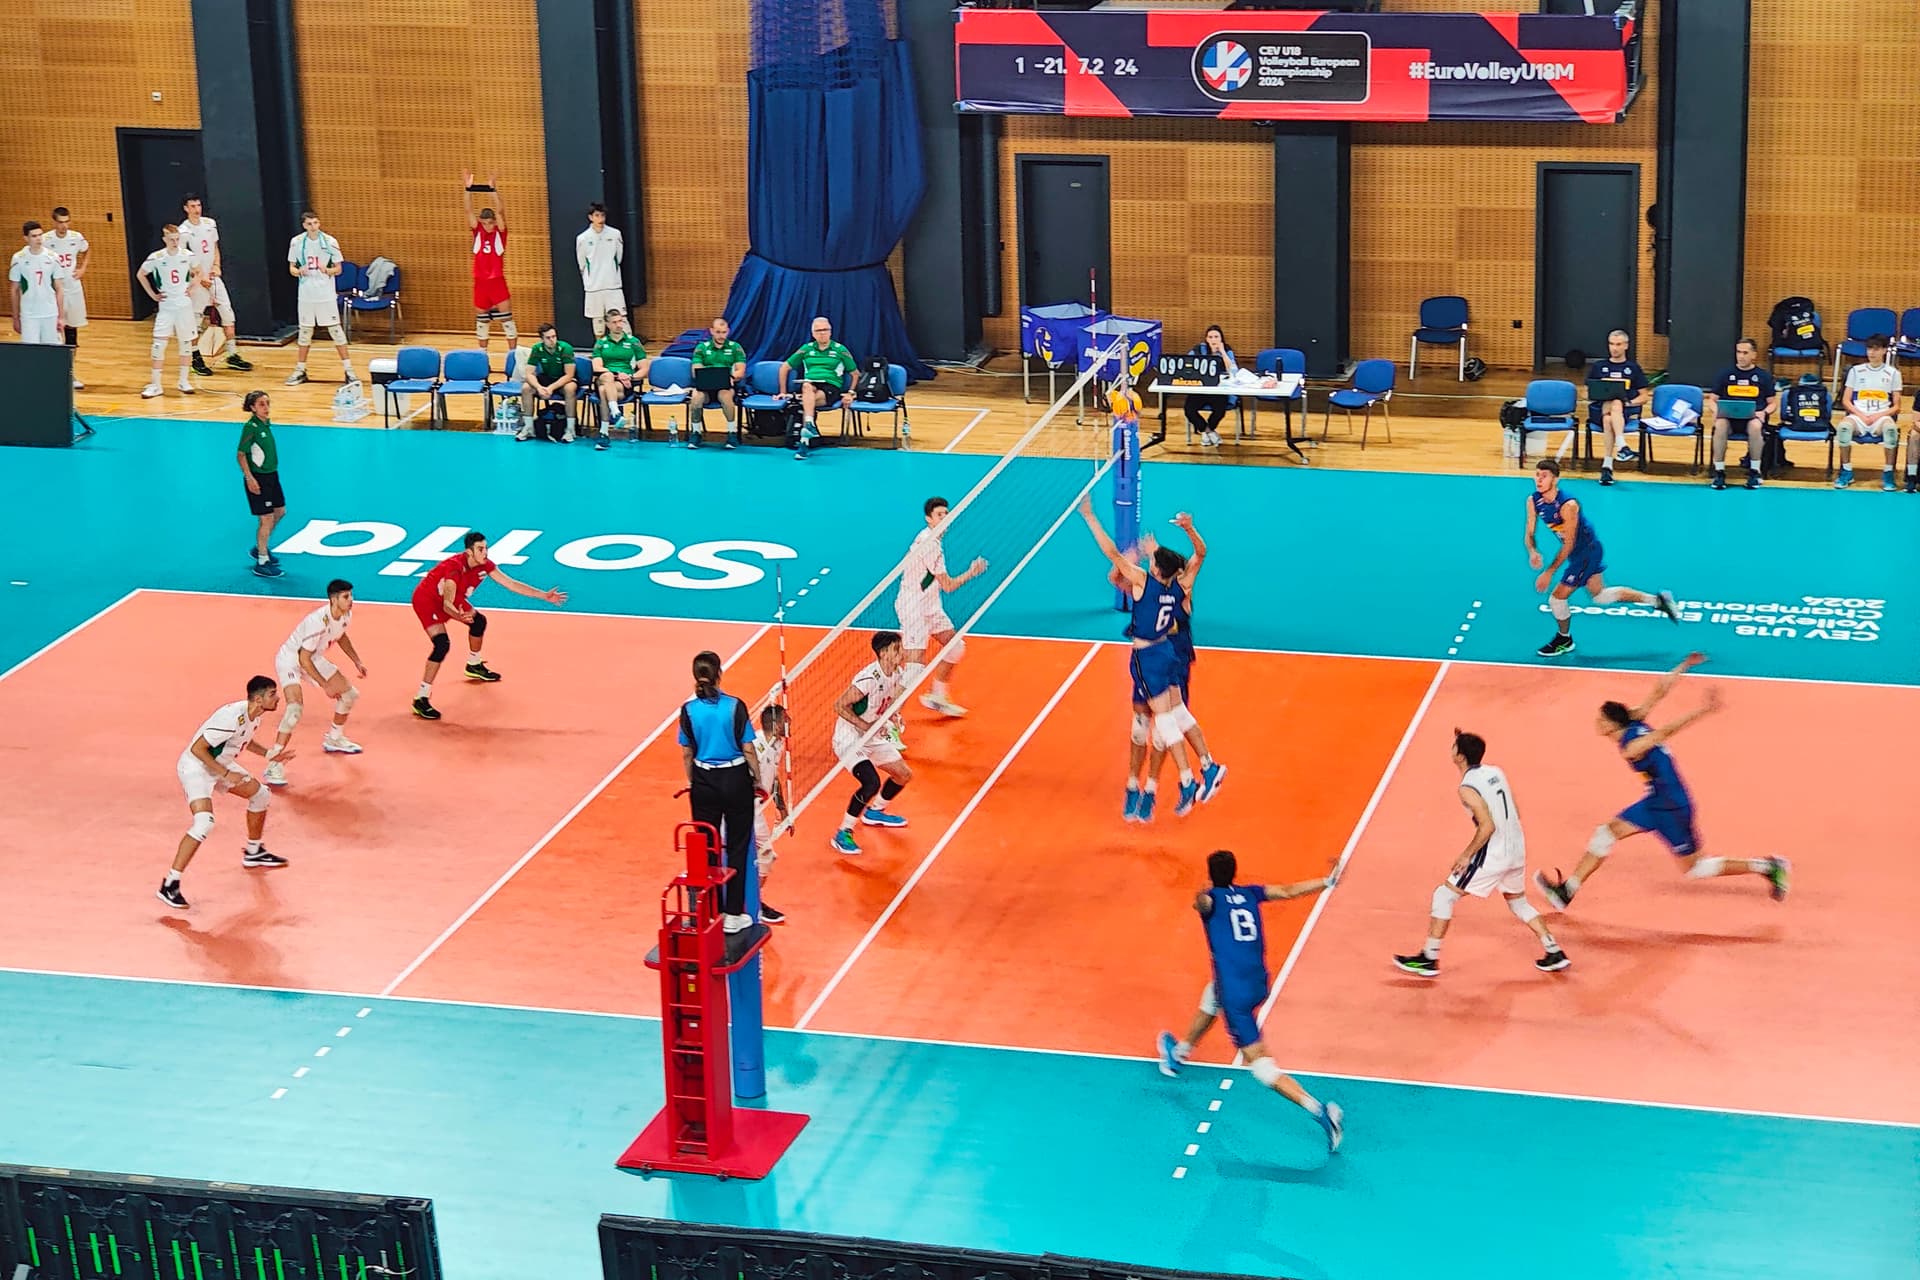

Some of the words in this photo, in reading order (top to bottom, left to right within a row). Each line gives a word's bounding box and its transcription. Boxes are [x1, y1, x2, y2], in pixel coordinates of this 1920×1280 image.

[1258, 46, 1281, 56] CEV
[1282, 46, 1302, 56] U18
[1015, 57, 1025, 74] 1
[1114, 58, 1139, 76] 24
[1258, 57, 1309, 68] Volleyball
[1310, 57, 1361, 69] European
[1258, 66, 1334, 79] Championship
[1408, 61, 1575, 84] #EuroVolleyU18M
[1258, 77, 1285, 87] 2024
[35, 270, 43, 286] 7
[170, 269, 180, 284] 6
[1801, 596, 1887, 609] 2024
[1155, 605, 1173, 633] 6
[1710, 613, 1881, 632] Volleyball
[1735, 625, 1797, 639] U18
[1804, 628, 1879, 642] CEV
